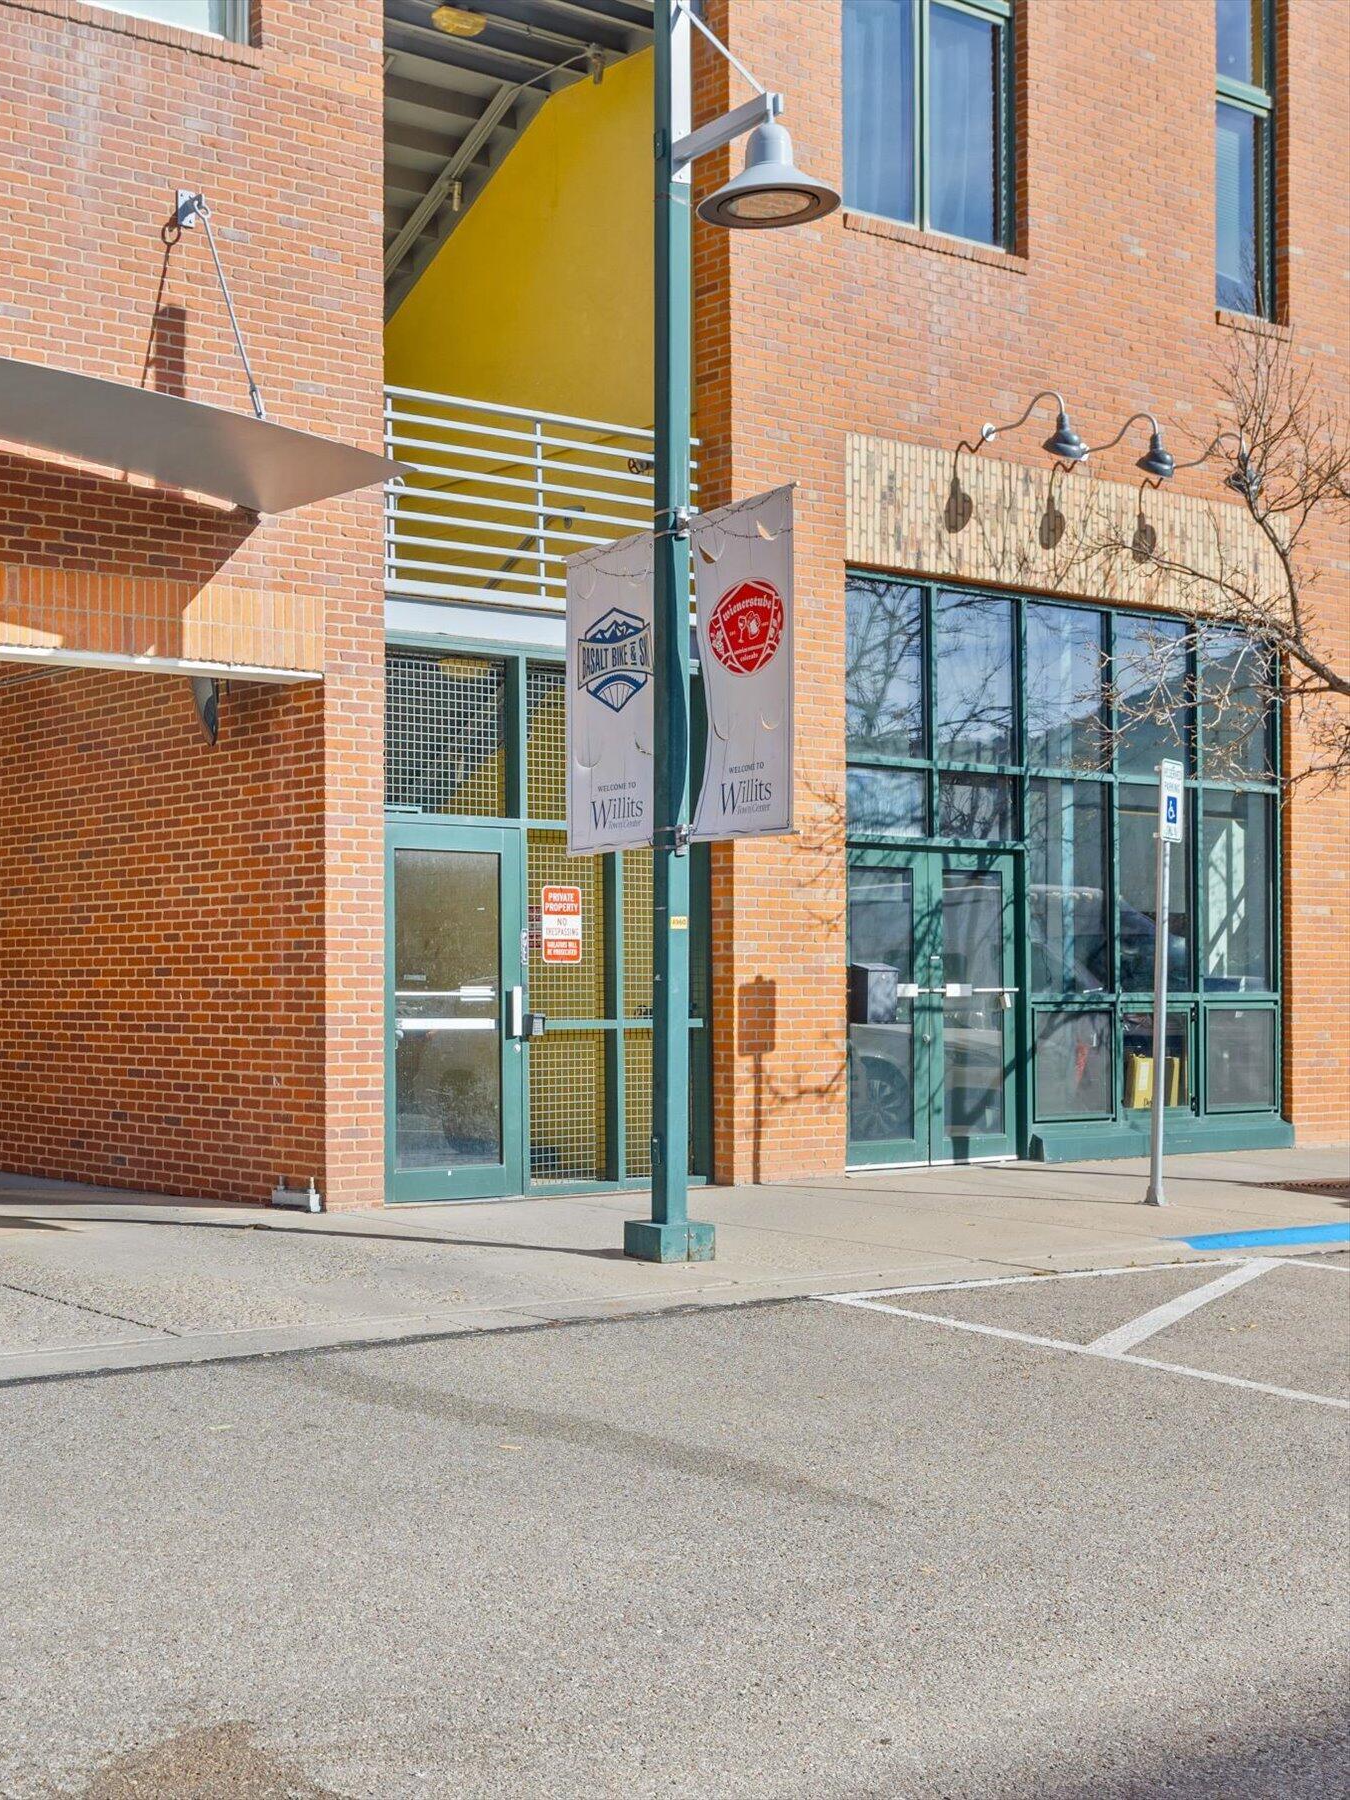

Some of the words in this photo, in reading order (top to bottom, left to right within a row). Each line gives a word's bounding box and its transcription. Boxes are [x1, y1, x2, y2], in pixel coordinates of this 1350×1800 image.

[582, 647, 609, 680] BASALT
[612, 644, 628, 667] BIKE
[630, 641, 637, 666] &
[729, 763, 755, 773] WELCOME
[755, 761, 764, 769] TO
[598, 783, 627, 792] WELCOME
[628, 781, 637, 789] TO
[721, 778, 772, 816] Willits
[590, 797, 643, 830] Willits
[548, 892, 574, 902] PRIVATE
[545, 902, 578, 912] PROPERTY
[557, 918, 567, 926] NO
[545, 927, 579, 936] TRESPASSING
